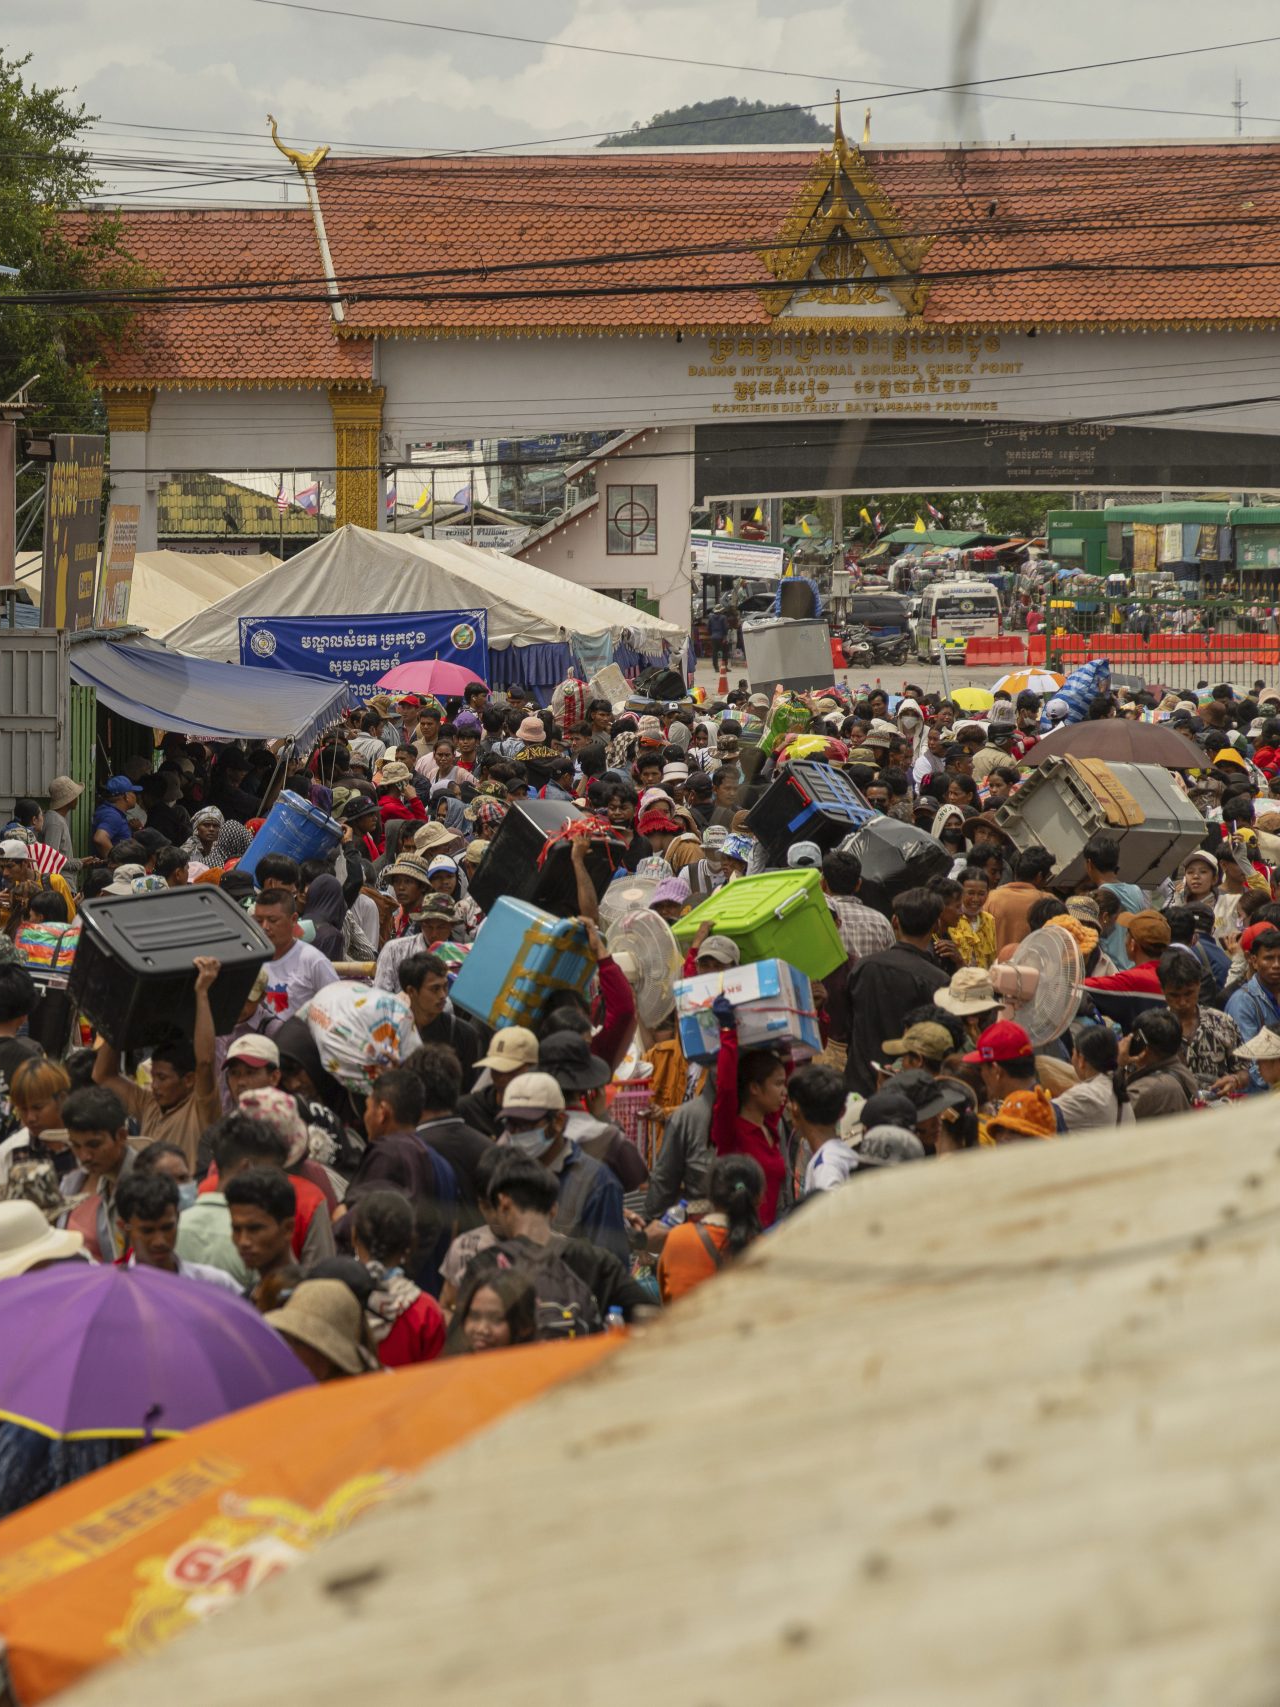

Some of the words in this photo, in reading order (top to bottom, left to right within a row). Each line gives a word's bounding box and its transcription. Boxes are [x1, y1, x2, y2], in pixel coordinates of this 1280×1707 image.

[741, 362, 856, 377] INTERNATIONAL
[861, 363, 919, 376] BORDER
[925, 362, 974, 375] CHECK
[980, 361, 1024, 374] POINT
[781, 402, 839, 413] DISTRICT
[936, 401, 999, 412] PROVINCE
